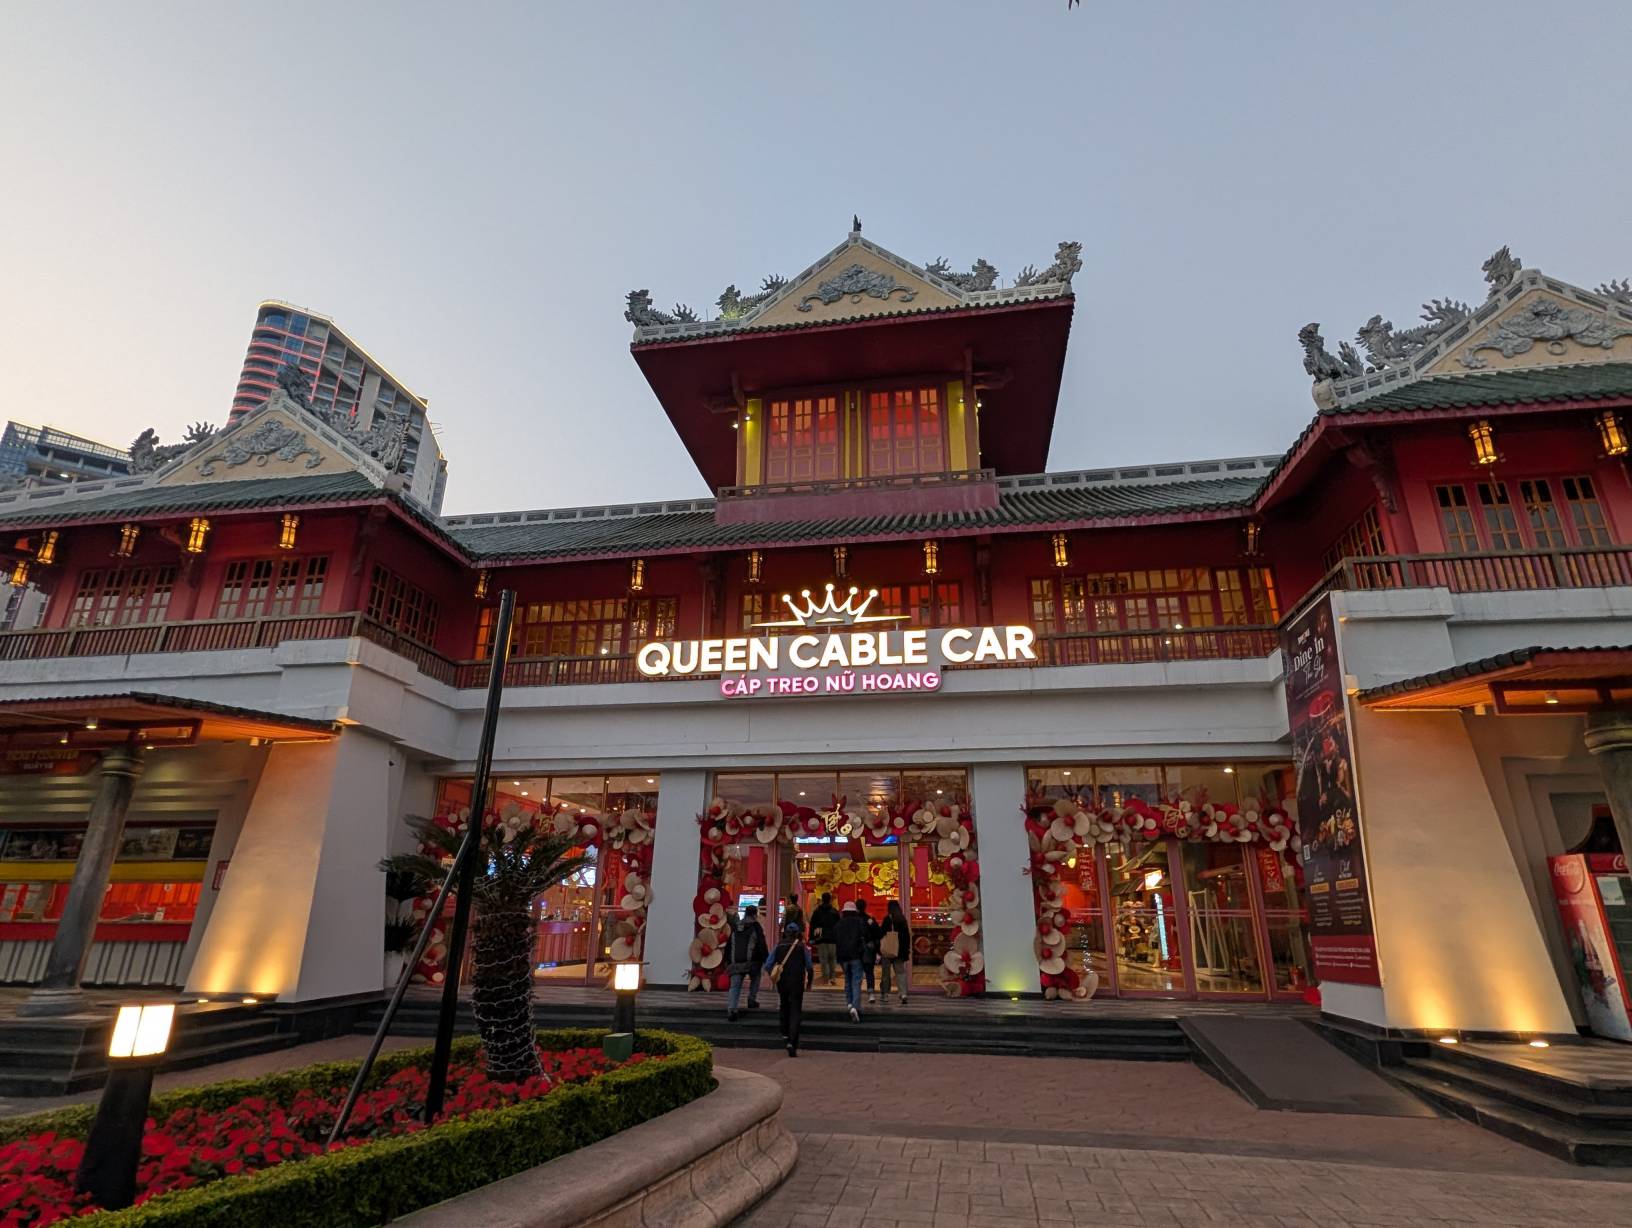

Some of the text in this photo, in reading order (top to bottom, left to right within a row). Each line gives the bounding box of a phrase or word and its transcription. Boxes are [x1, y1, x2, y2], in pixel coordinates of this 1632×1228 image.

[637, 625, 1037, 675] QUEEN CABLE CAR
[1294, 646, 1313, 673] Dine
[1314, 636, 1325, 655] In
[721, 673, 762, 696] CÁP
[766, 676, 820, 693] TREO
[825, 670, 856, 692] NỮ
